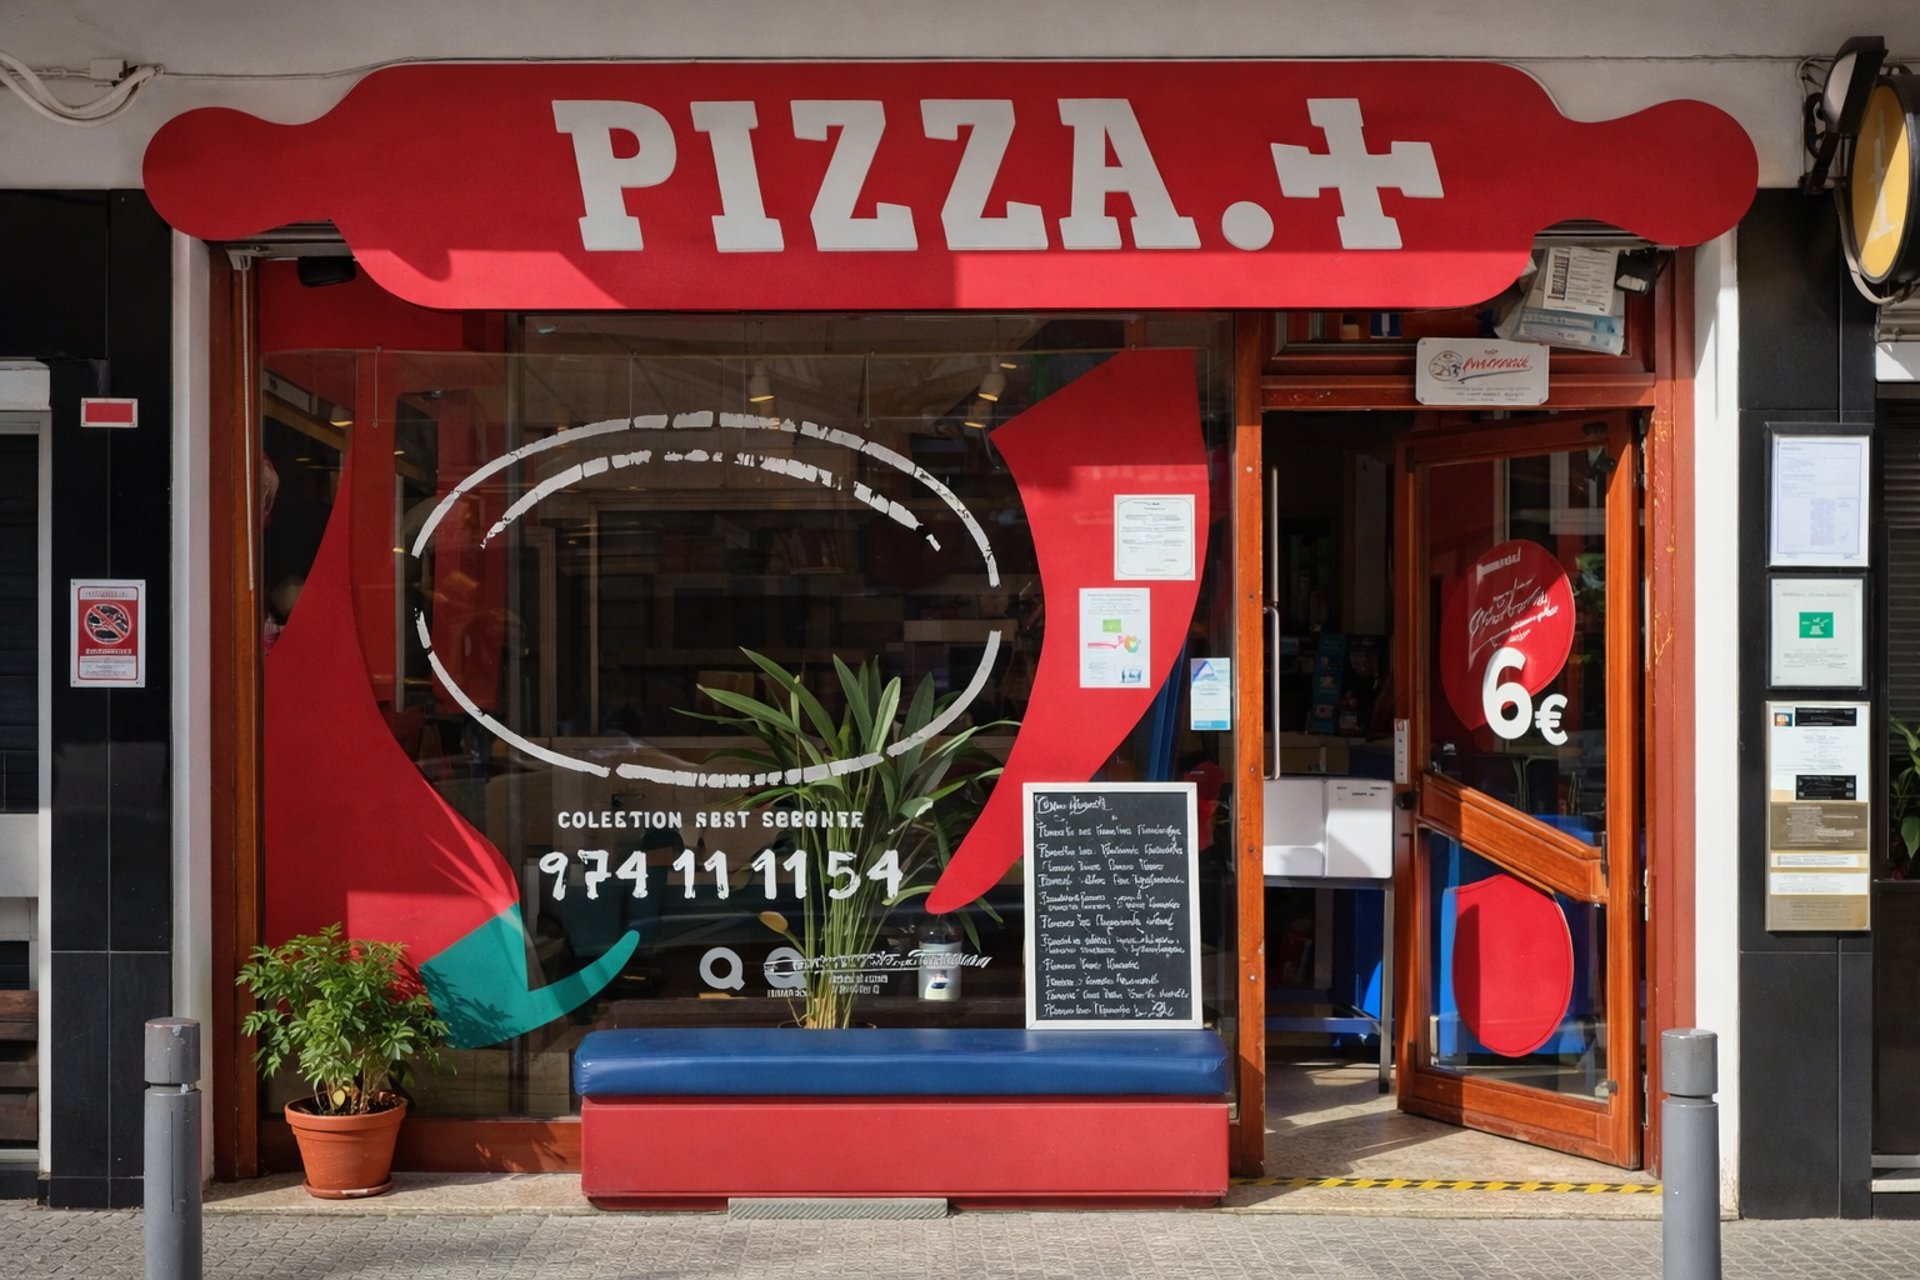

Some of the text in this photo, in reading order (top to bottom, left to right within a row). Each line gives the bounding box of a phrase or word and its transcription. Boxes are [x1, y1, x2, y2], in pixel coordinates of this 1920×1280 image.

[1482, 646, 1569, 746] 6€
[539, 849, 650, 901] 974
[827, 849, 904, 900] 54
